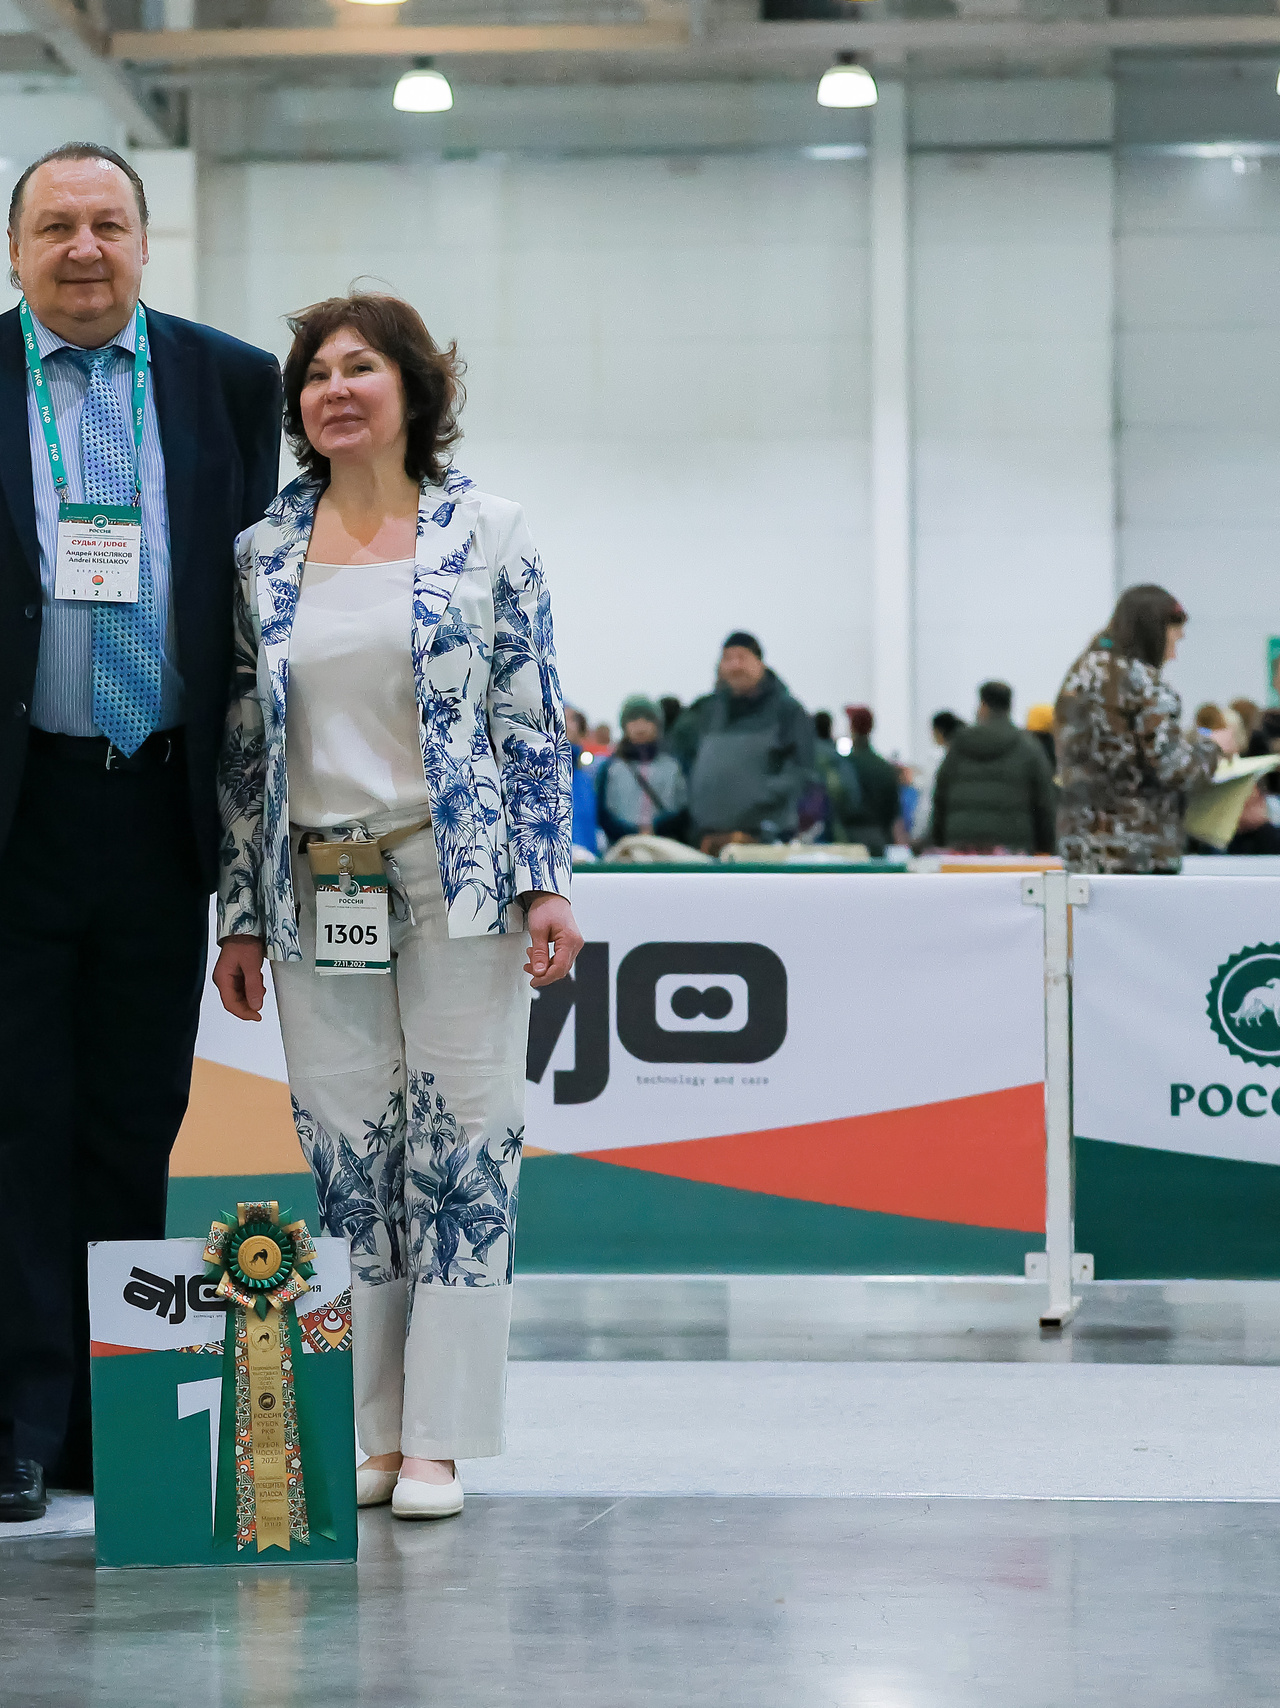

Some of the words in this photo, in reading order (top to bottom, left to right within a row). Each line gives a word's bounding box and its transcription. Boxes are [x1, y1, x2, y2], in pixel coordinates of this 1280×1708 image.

[25, 332, 35, 350] РКФ
[138, 335, 146, 352] РКФ
[33, 368, 43, 387] РКФ
[136, 370, 145, 388] РКФ
[41, 405, 52, 424] РКФ
[49, 443, 60, 462] РКФ
[71, 539, 97, 547] СУДЬЯ
[66, 549, 92, 557] Андрей
[324, 924, 378, 945] 1305
[333, 960, 366, 968] 27.11.2022
[1170, 1083, 1280, 1118] РОС
